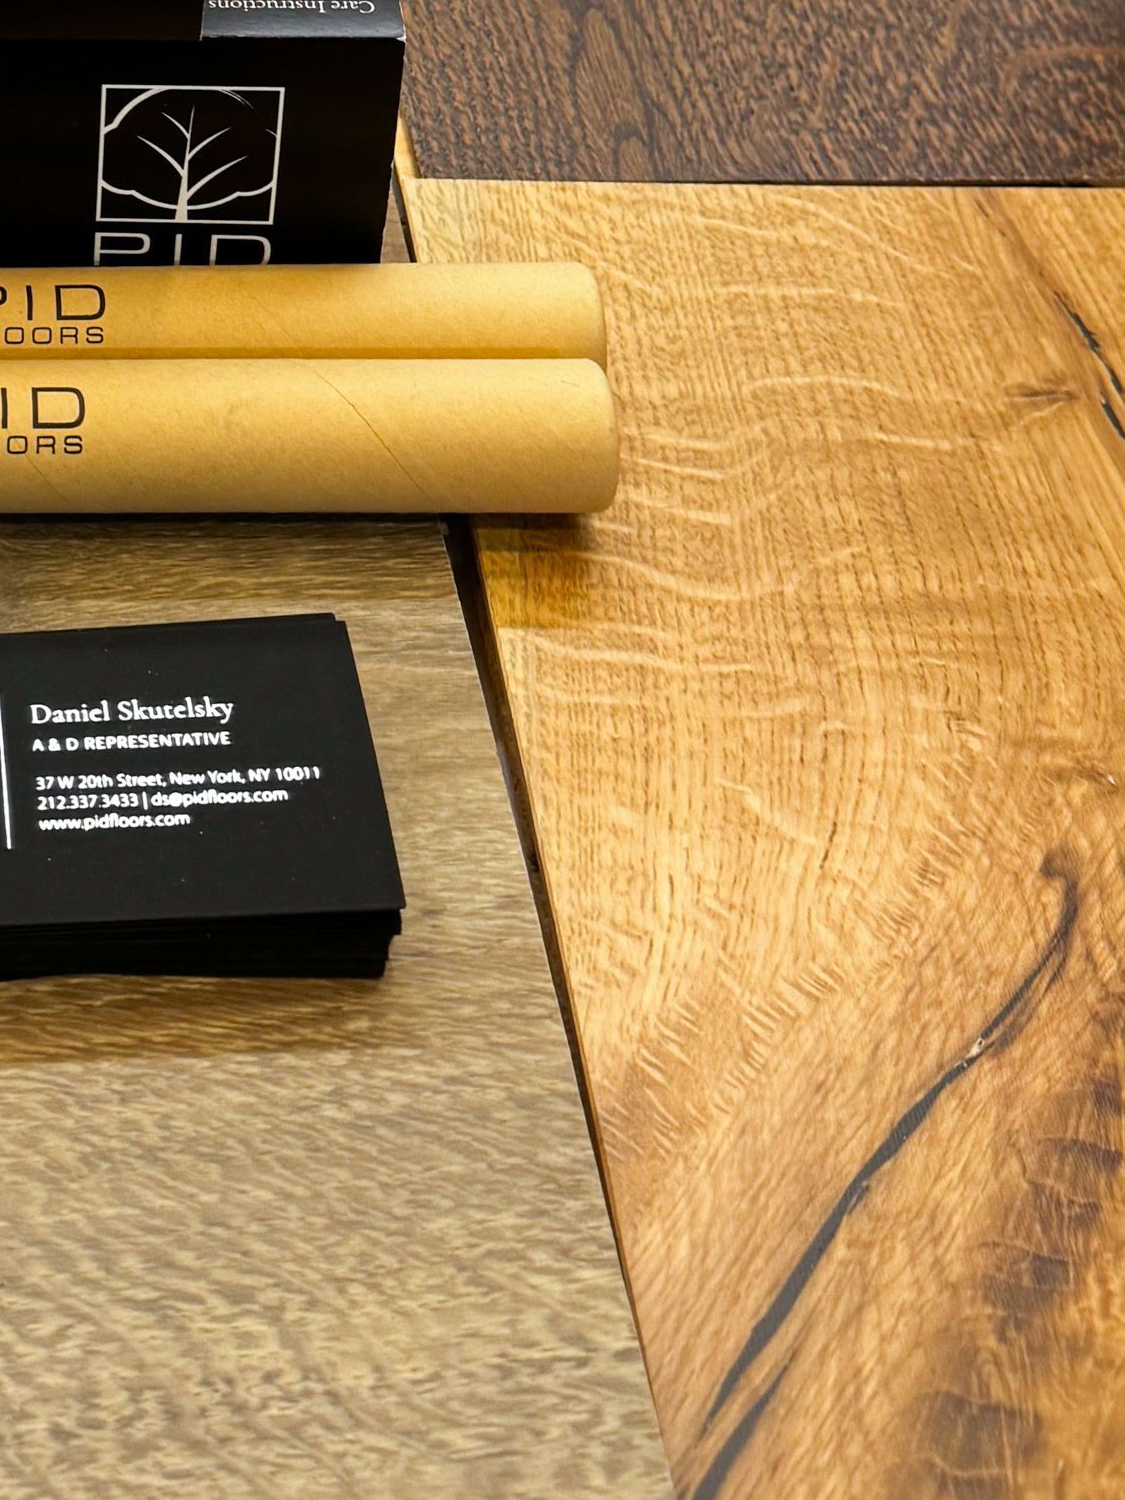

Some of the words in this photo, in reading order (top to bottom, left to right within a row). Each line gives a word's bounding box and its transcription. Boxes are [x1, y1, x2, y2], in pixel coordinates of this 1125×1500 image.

[208, 0, 325, 12] Instructions
[329, 0, 375, 12] Care
[93, 232, 272, 266] PID
[30, 700, 110, 724] Daniel
[117, 696, 234, 724] Skutelsky
[32, 739, 45, 752] A
[48, 738, 62, 751] &
[66, 737, 79, 751] D
[84, 731, 231, 750] REPRESENTATIVE
[35, 776, 55, 790] 37
[57, 775, 75, 789] W
[77, 773, 113, 789] 20th
[117, 772, 167, 788] Street,
[170, 771, 205, 786] New
[207, 769, 246, 785] York,
[248, 768, 270, 782] NY
[275, 766, 320, 781] 10011
[37, 793, 139, 811] 212.337.3433
[150, 789, 289, 808] ds@pidfloors.com
[38, 813, 191, 831] www.pidfloors.com
